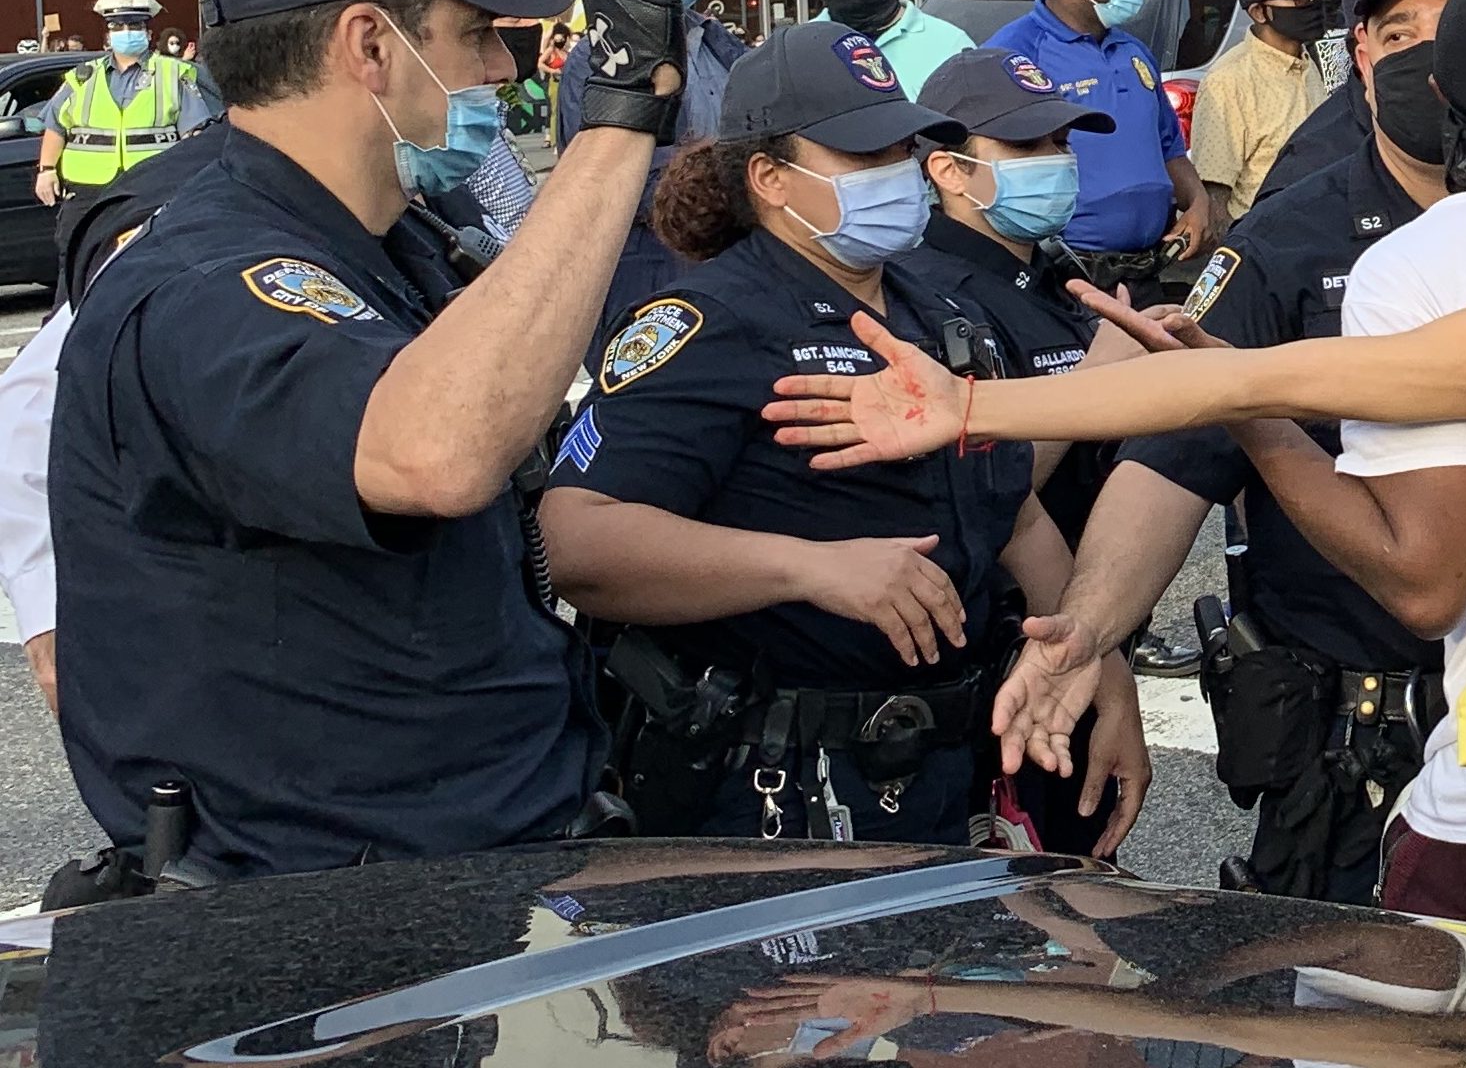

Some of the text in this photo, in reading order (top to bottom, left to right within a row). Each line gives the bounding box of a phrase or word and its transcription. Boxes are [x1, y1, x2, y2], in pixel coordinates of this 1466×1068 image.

[842, 35, 871, 50] NYPD
[155, 132, 177, 144] PD
[1361, 216, 1383, 230] S2
[1015, 271, 1031, 289] S2
[271, 289, 307, 305] CITY
[1198, 285, 1221, 312] YORK
[813, 302, 836, 314] S2
[621, 338, 681, 381] NEW YORK
[792, 345, 873, 362] SGT. SANCHEZ
[1033, 349, 1086, 368] GALLARDO
[826, 360, 856, 374] 546
